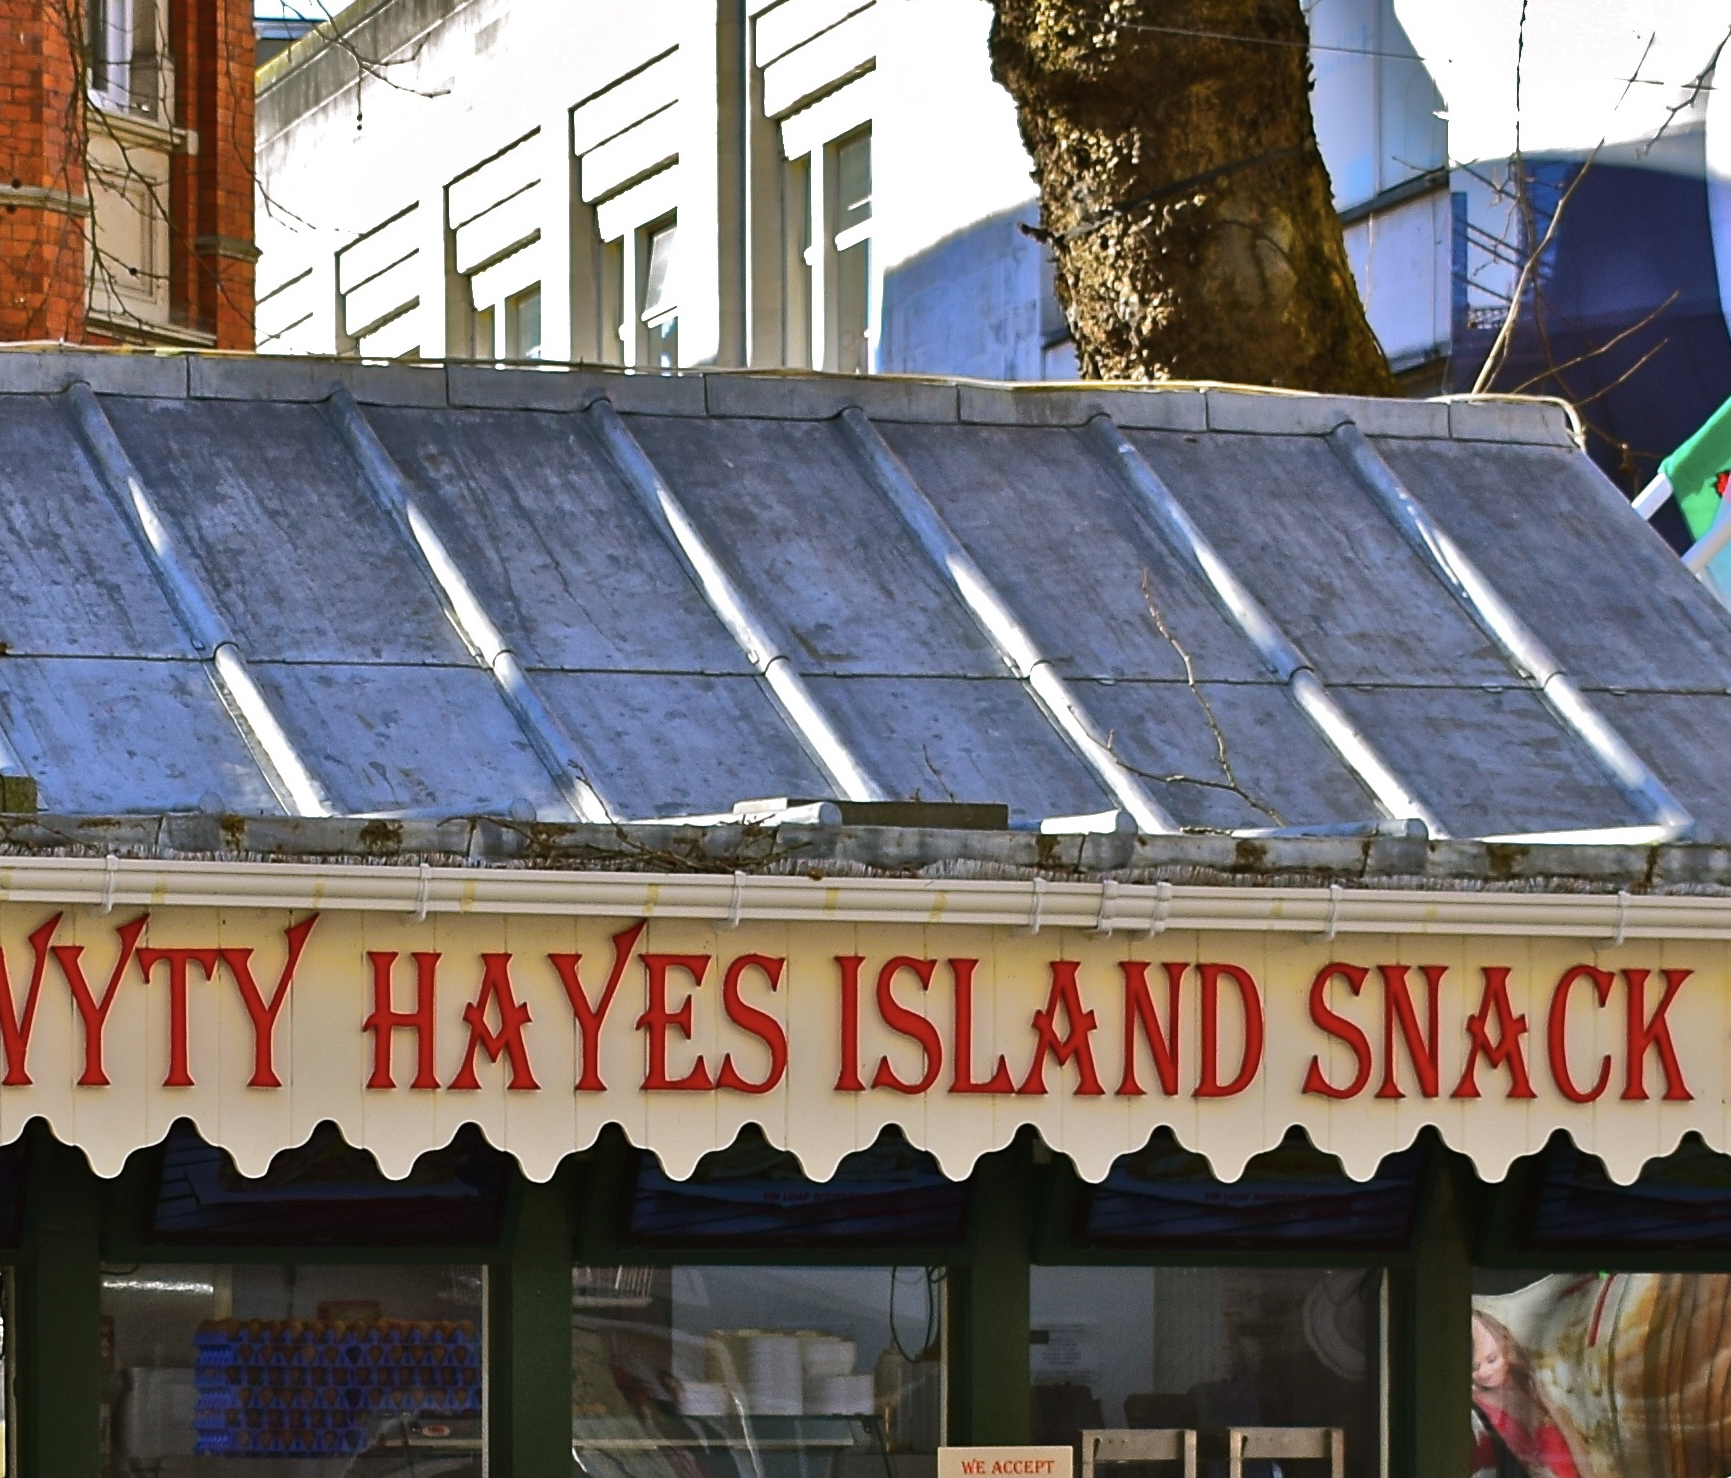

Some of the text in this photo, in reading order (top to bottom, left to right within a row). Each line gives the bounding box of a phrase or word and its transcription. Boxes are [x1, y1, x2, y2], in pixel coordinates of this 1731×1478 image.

[363, 918, 786, 1094] HAYES
[833, 953, 1264, 1099] ISLAND
[1302, 961, 1696, 1105] SNACK
[961, 1459, 1055, 1475] WE ACCEPT
